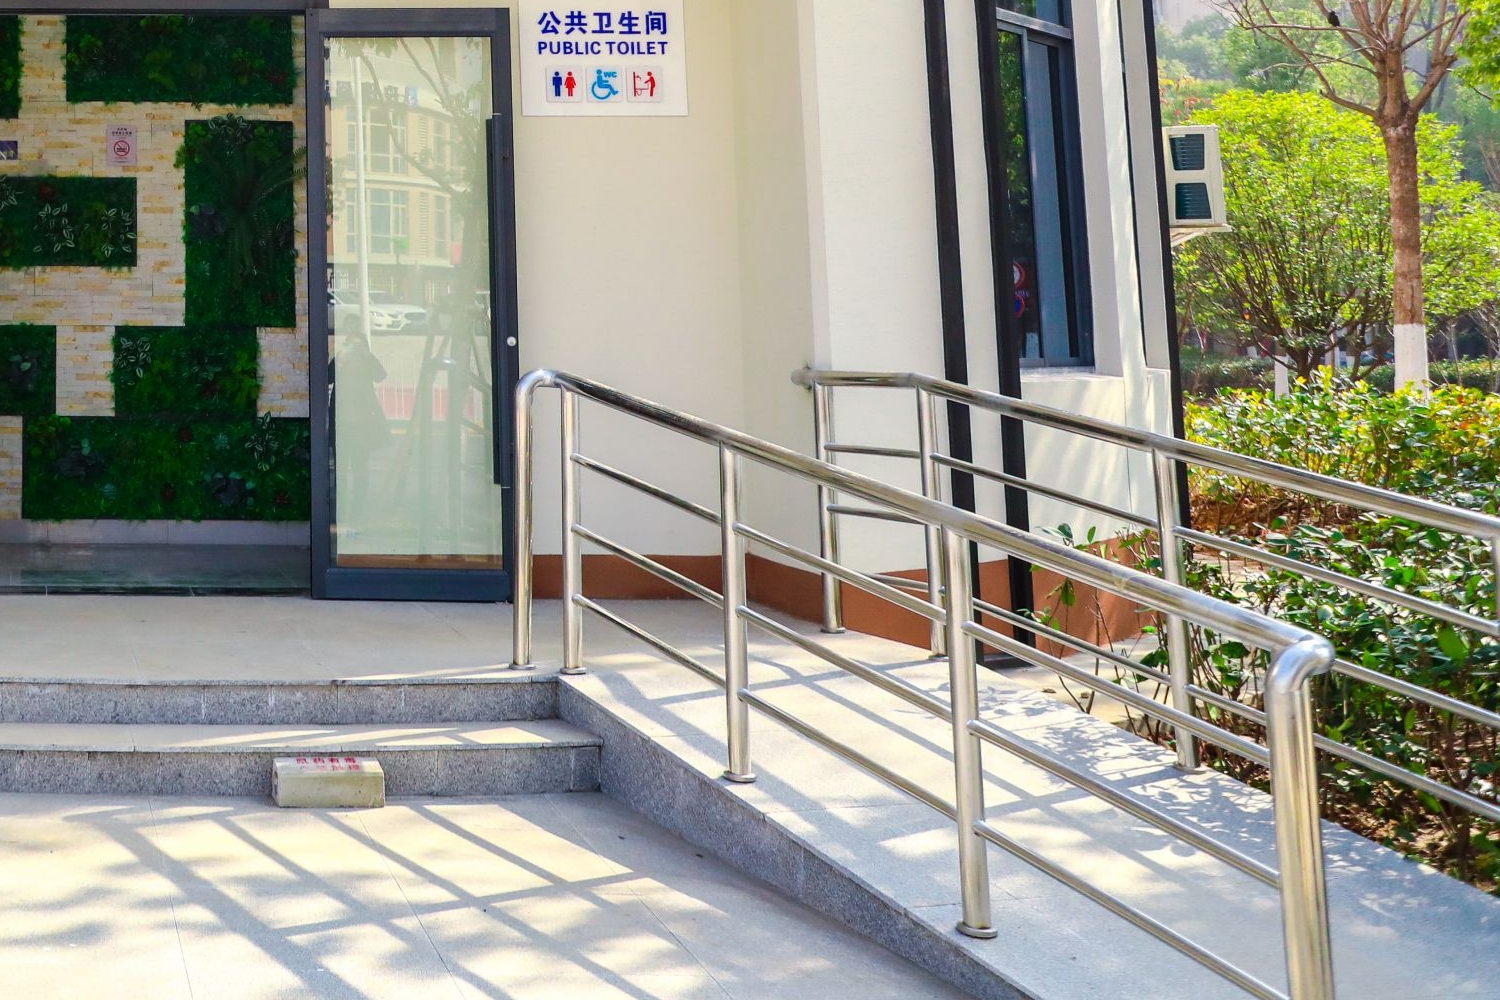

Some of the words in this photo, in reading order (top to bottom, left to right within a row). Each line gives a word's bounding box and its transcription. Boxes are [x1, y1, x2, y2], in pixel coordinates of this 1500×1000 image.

[537, 10, 668, 35] 公共卫生间
[537, 41, 601, 55] PUBLIC
[605, 41, 668, 55] TOILET
